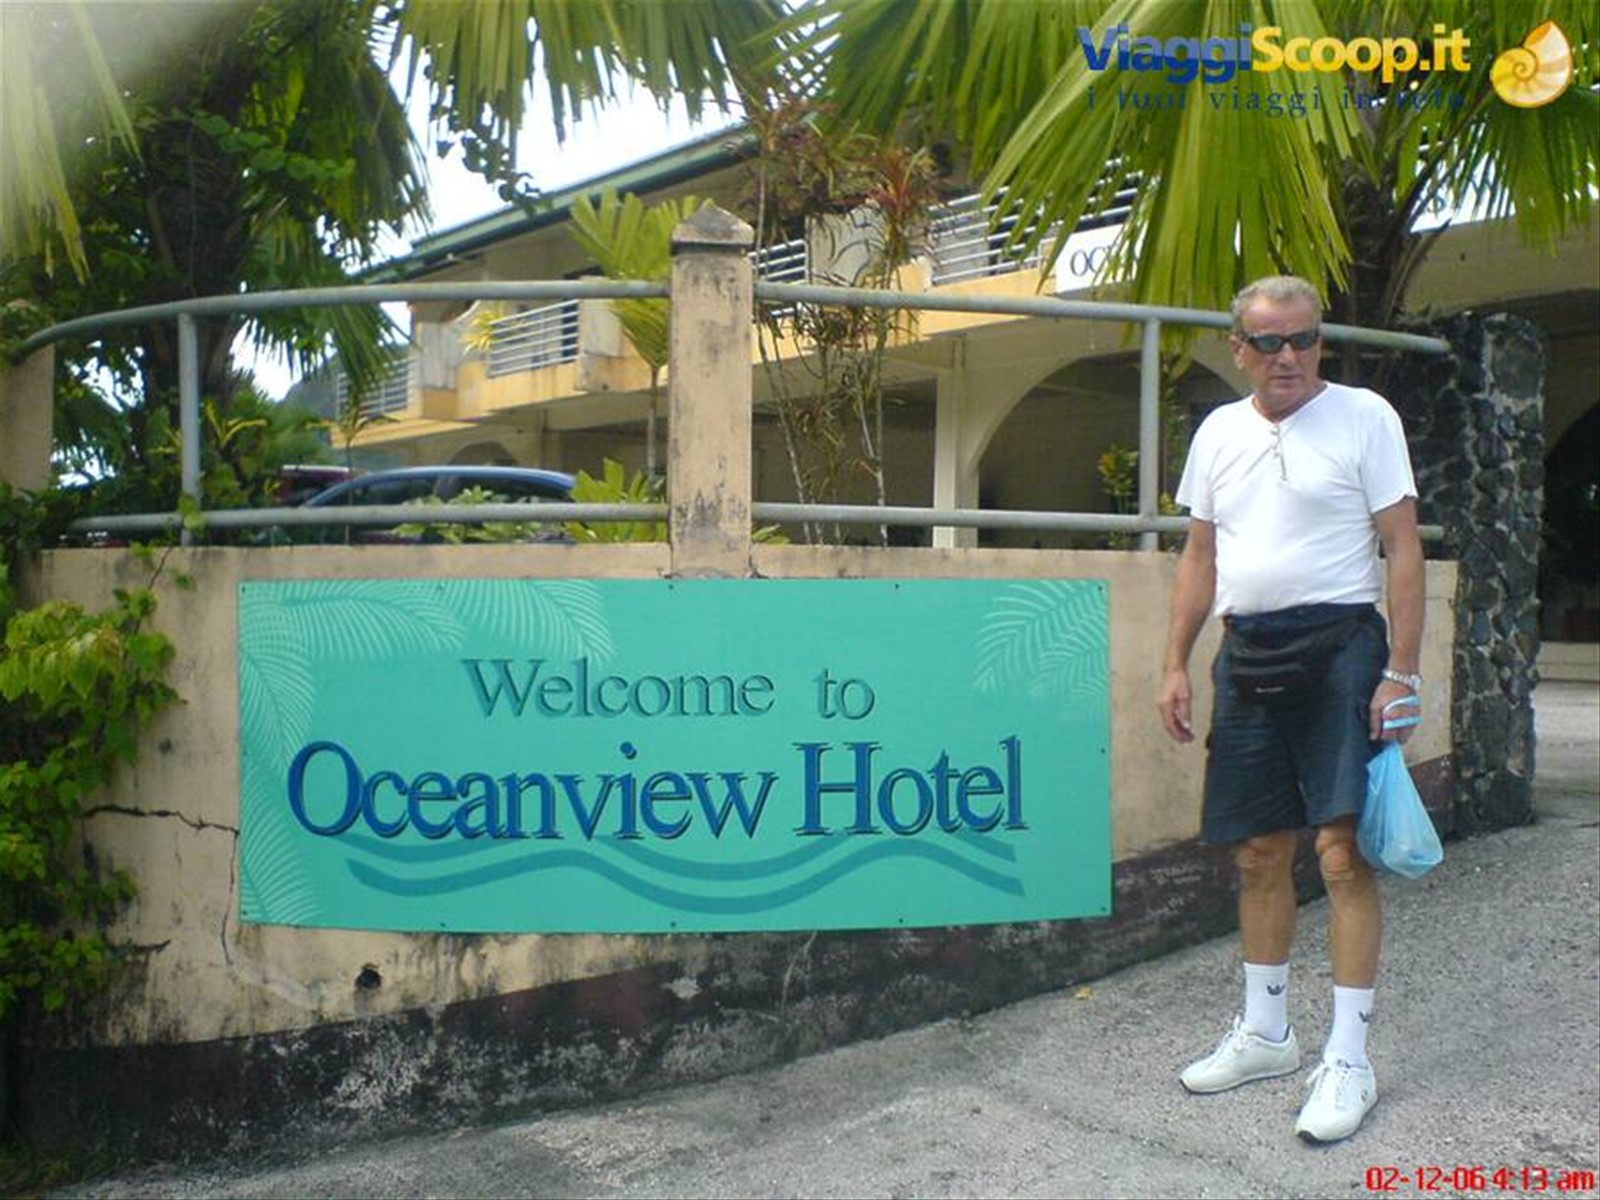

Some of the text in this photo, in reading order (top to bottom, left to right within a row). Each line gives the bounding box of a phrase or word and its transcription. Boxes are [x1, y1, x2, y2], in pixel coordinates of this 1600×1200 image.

[461, 656, 875, 720] Welcome to
[287, 734, 1029, 841] Oceanview Hotel
